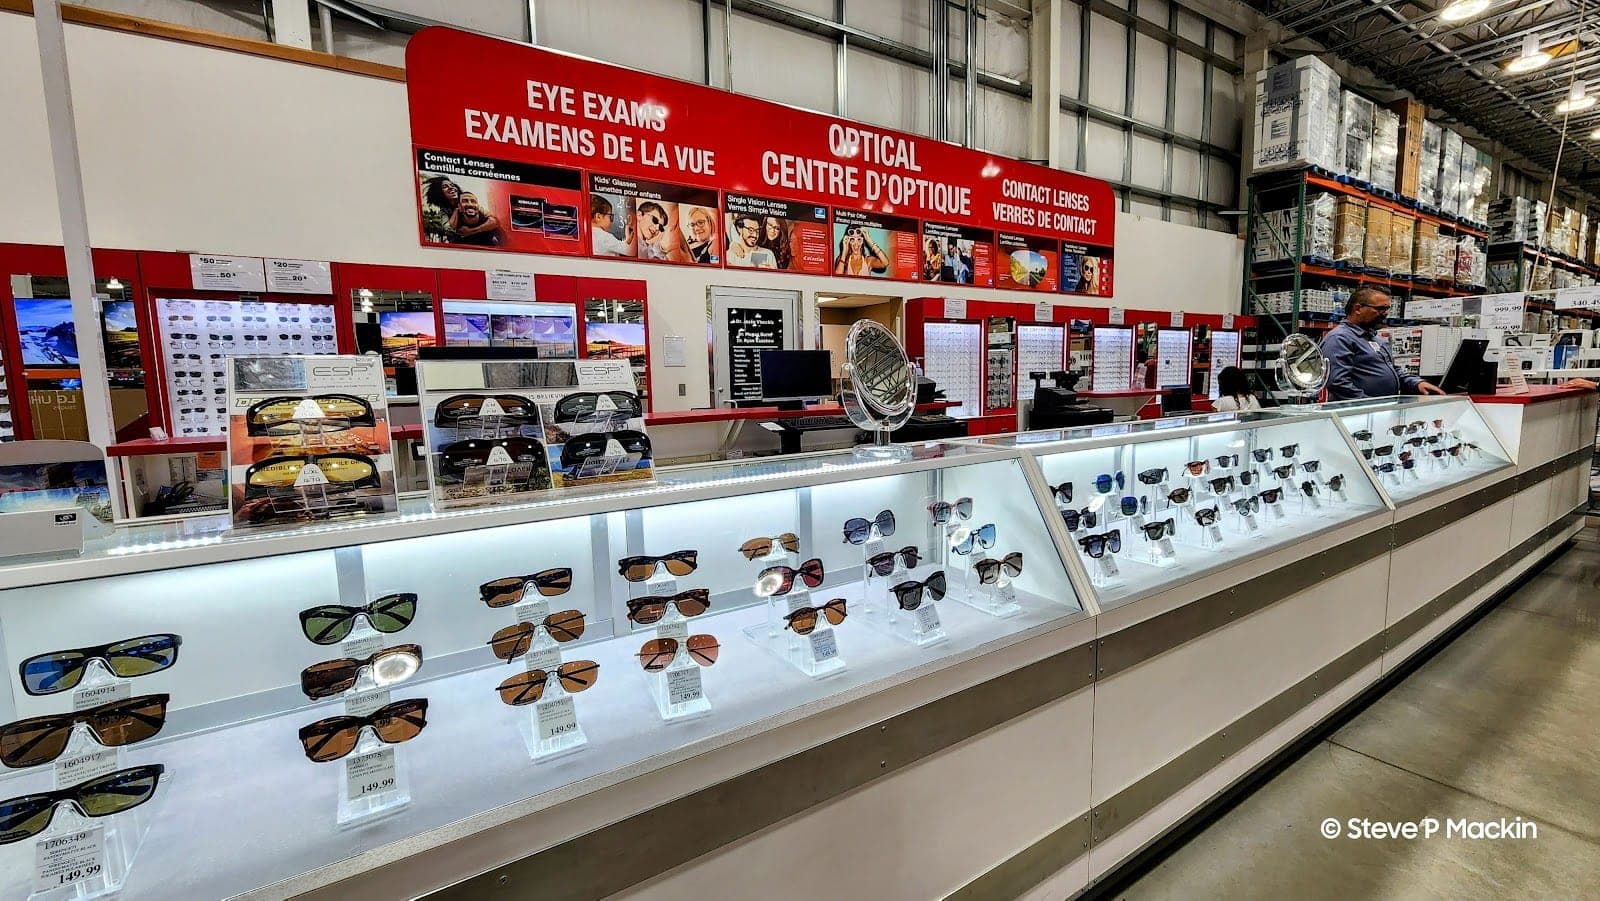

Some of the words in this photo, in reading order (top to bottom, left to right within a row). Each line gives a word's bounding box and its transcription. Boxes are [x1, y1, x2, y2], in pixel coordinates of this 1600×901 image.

[526, 80, 576, 116] EYE
[582, 92, 667, 132] EXAMS
[464, 108, 596, 157] EXAMENS
[603, 133, 633, 163] DE
[641, 139, 669, 167] LA
[675, 145, 715, 176] VUE
[828, 123, 922, 172] OPTICAL
[424, 152, 461, 165] Contact
[463, 158, 495, 170] Lenses
[425, 162, 465, 175] Lentilles
[468, 168, 521, 182] cornéennes
[594, 176, 611, 186] Kids'
[612, 178, 637, 189] Glasses
[762, 150, 859, 198] CENTRE
[866, 170, 971, 217] D'OPTIQUE
[594, 186, 622, 196] Lunettes
[624, 188, 639, 198] pour
[640, 190, 662, 200] enfants
[1002, 178, 1051, 206] CONTACT
[1053, 187, 1090, 213] LENSES
[727, 195, 746, 206] Single
[748, 197, 764, 207] Vision
[765, 199, 788, 210] Lenses
[728, 202, 747, 212] Verres
[748, 205, 768, 216] Simple
[769, 208, 787, 218] Vision
[993, 201, 1036, 227] VERRES
[1037, 208, 1052, 229] DE
[1053, 210, 1097, 236] CONTACT
[80, 686, 116, 698] 1604914
[550, 722, 576, 737] 149.99
[64, 752, 102, 769] 1604917
[361, 778, 394, 794] 149.99
[44, 832, 86, 850] 1706349
[60, 864, 101, 884] 149.99
